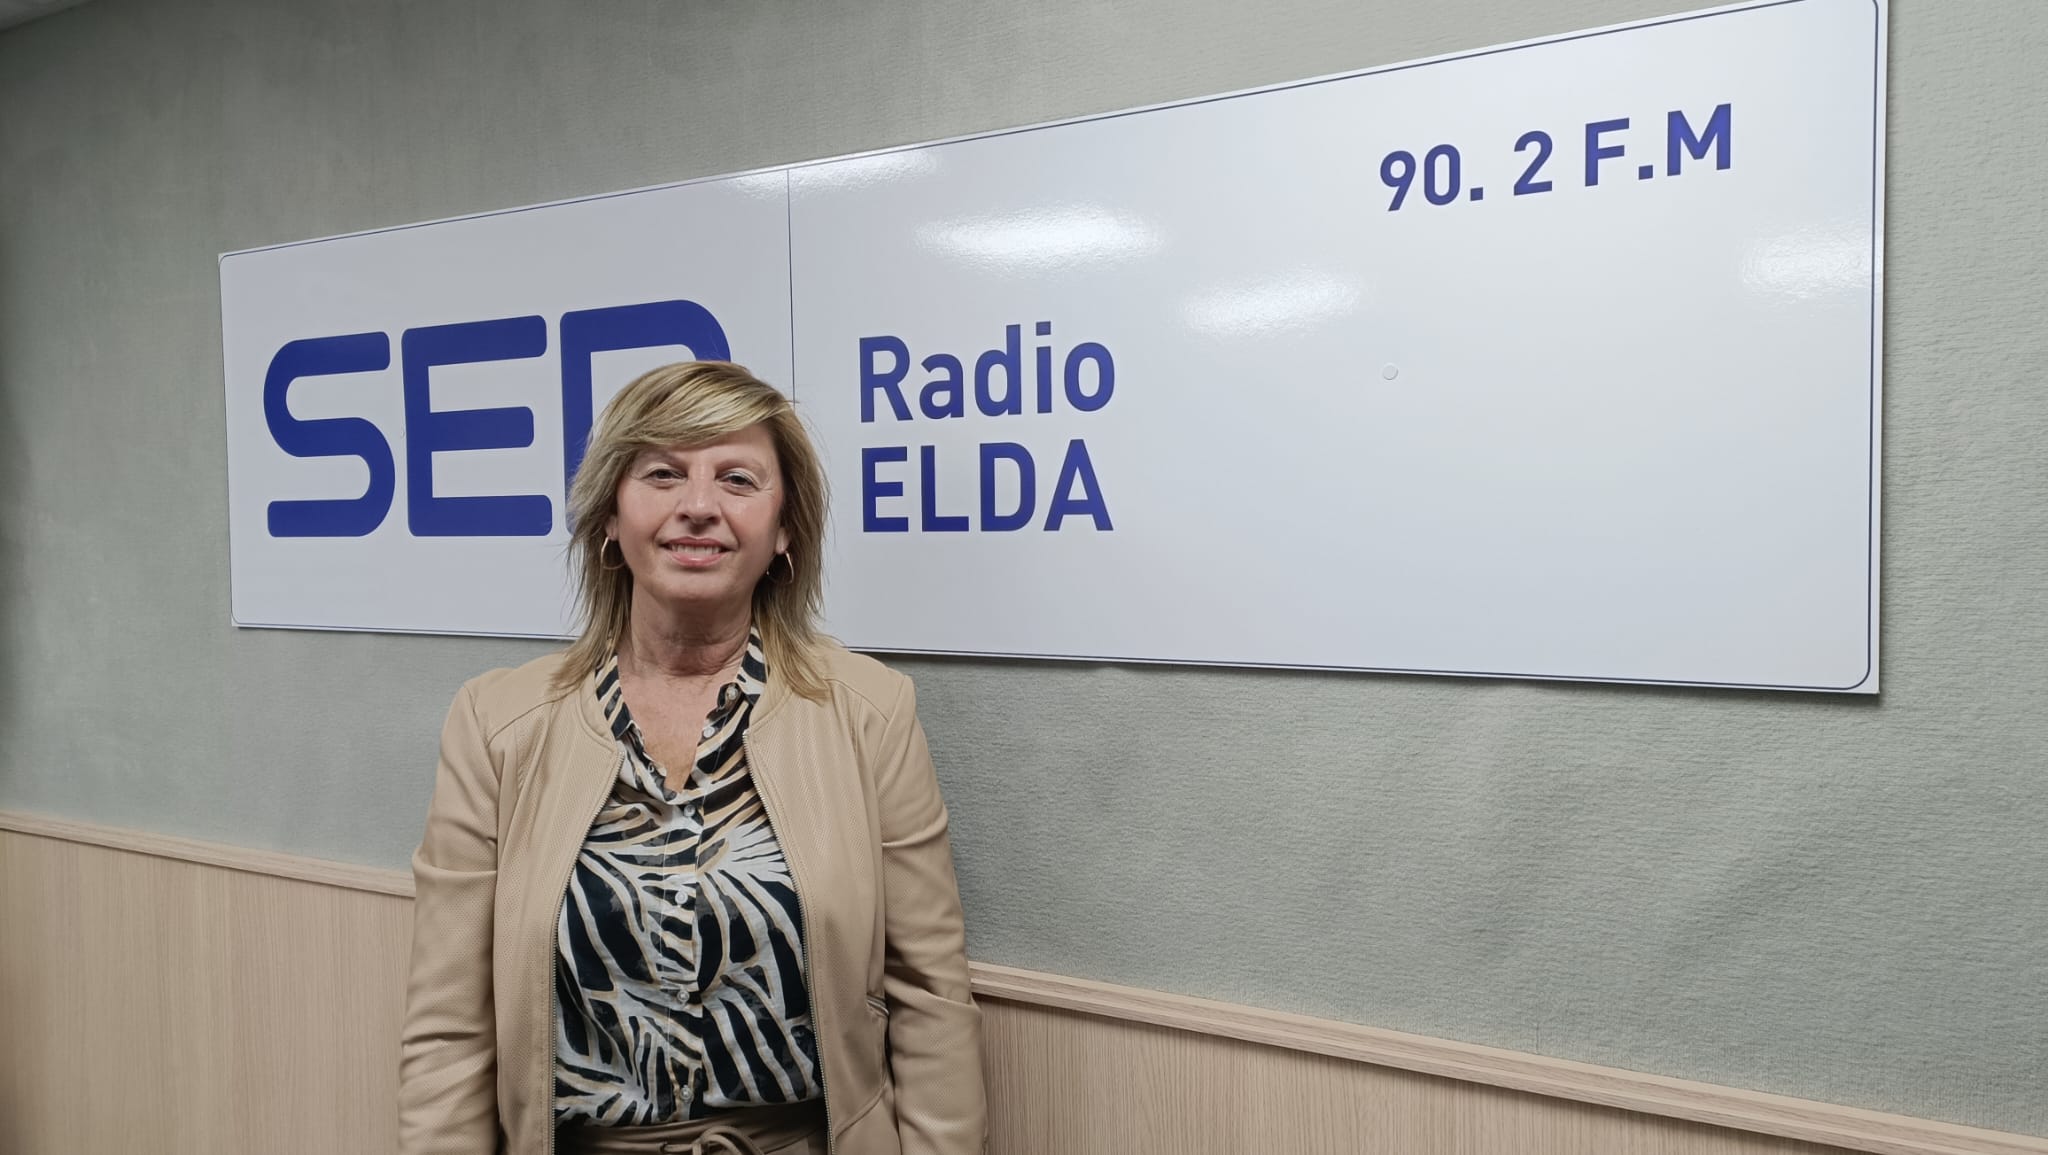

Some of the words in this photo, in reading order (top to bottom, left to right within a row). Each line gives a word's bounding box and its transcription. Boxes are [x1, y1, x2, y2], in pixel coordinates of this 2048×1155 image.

[1379, 143, 1485, 212] 90.
[1513, 129, 1554, 197] 2
[1584, 103, 1733, 188] F.M
[858, 320, 1117, 423] Radio
[861, 437, 1114, 534] ELDA
